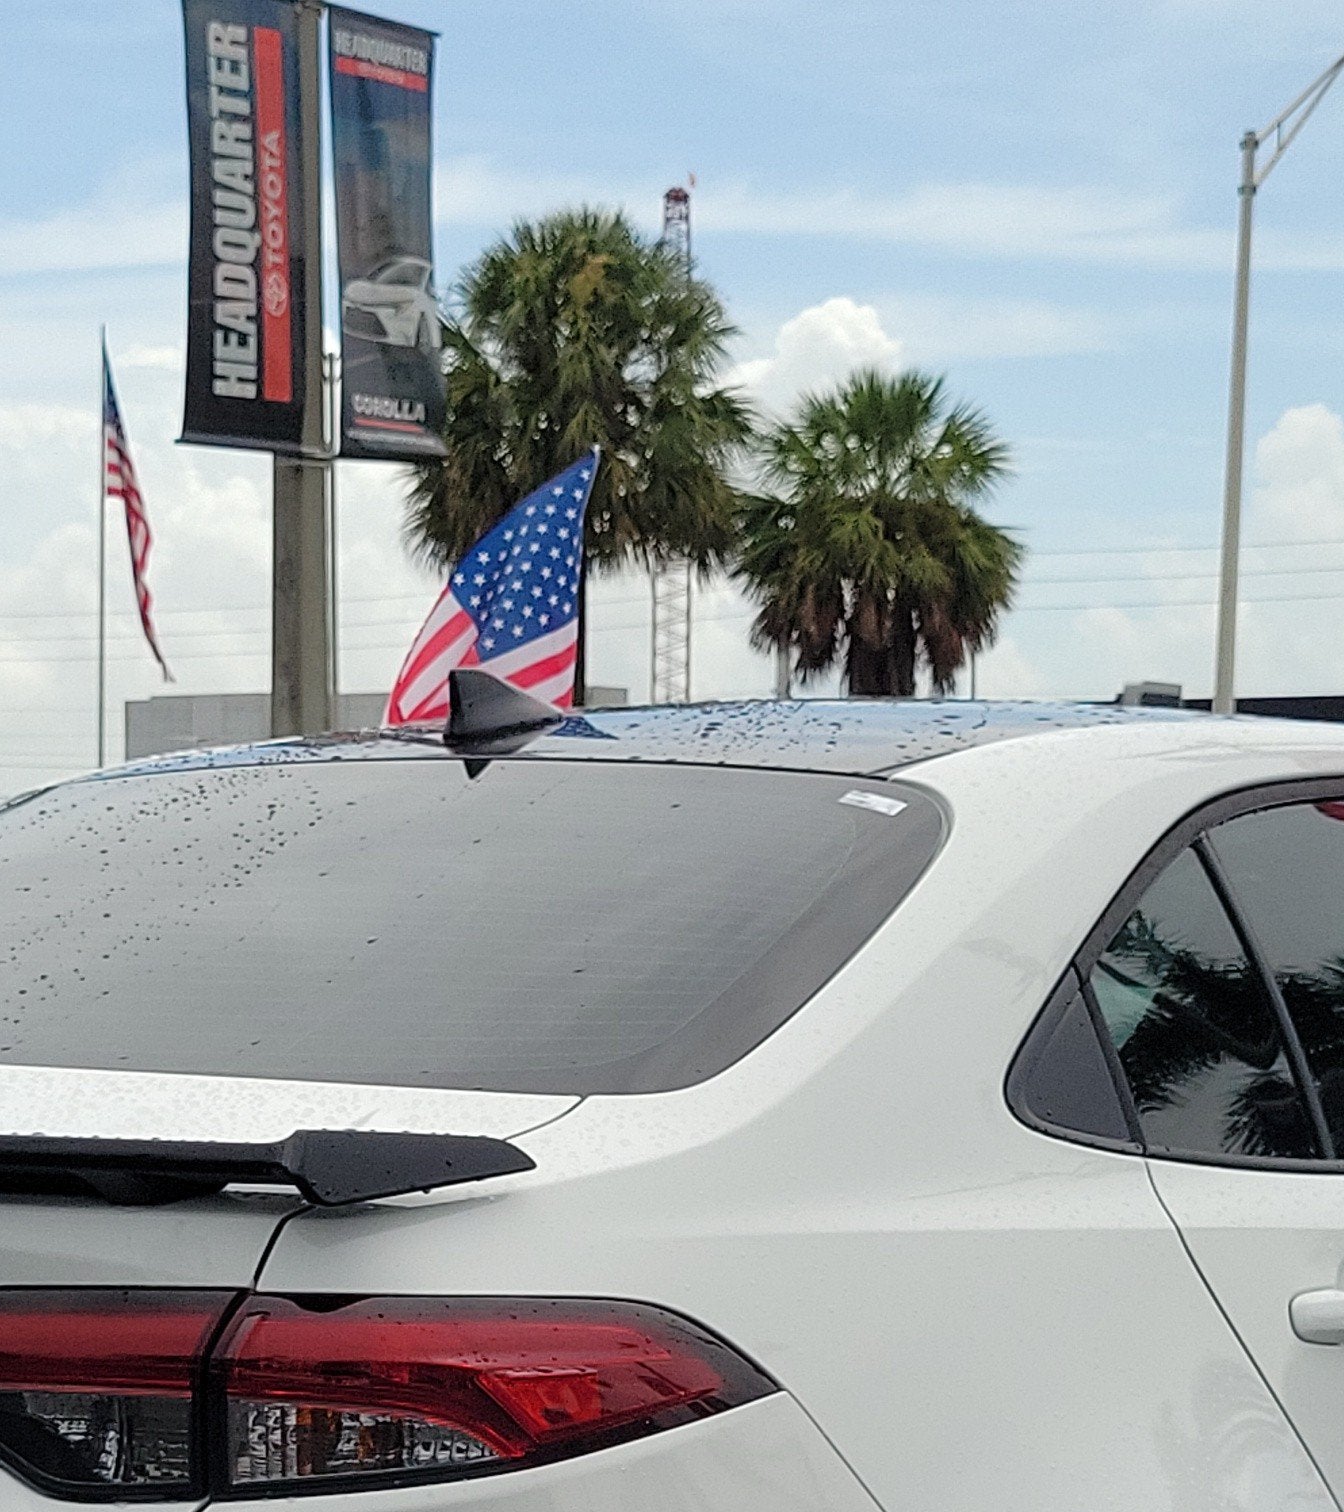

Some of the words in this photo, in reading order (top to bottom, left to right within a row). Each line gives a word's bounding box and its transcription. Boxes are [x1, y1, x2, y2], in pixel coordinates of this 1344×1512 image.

[207, 21, 260, 399] HEADQUARTER
[262, 131, 284, 266] TOYOTA
[353, 394, 425, 422] COROLLA
